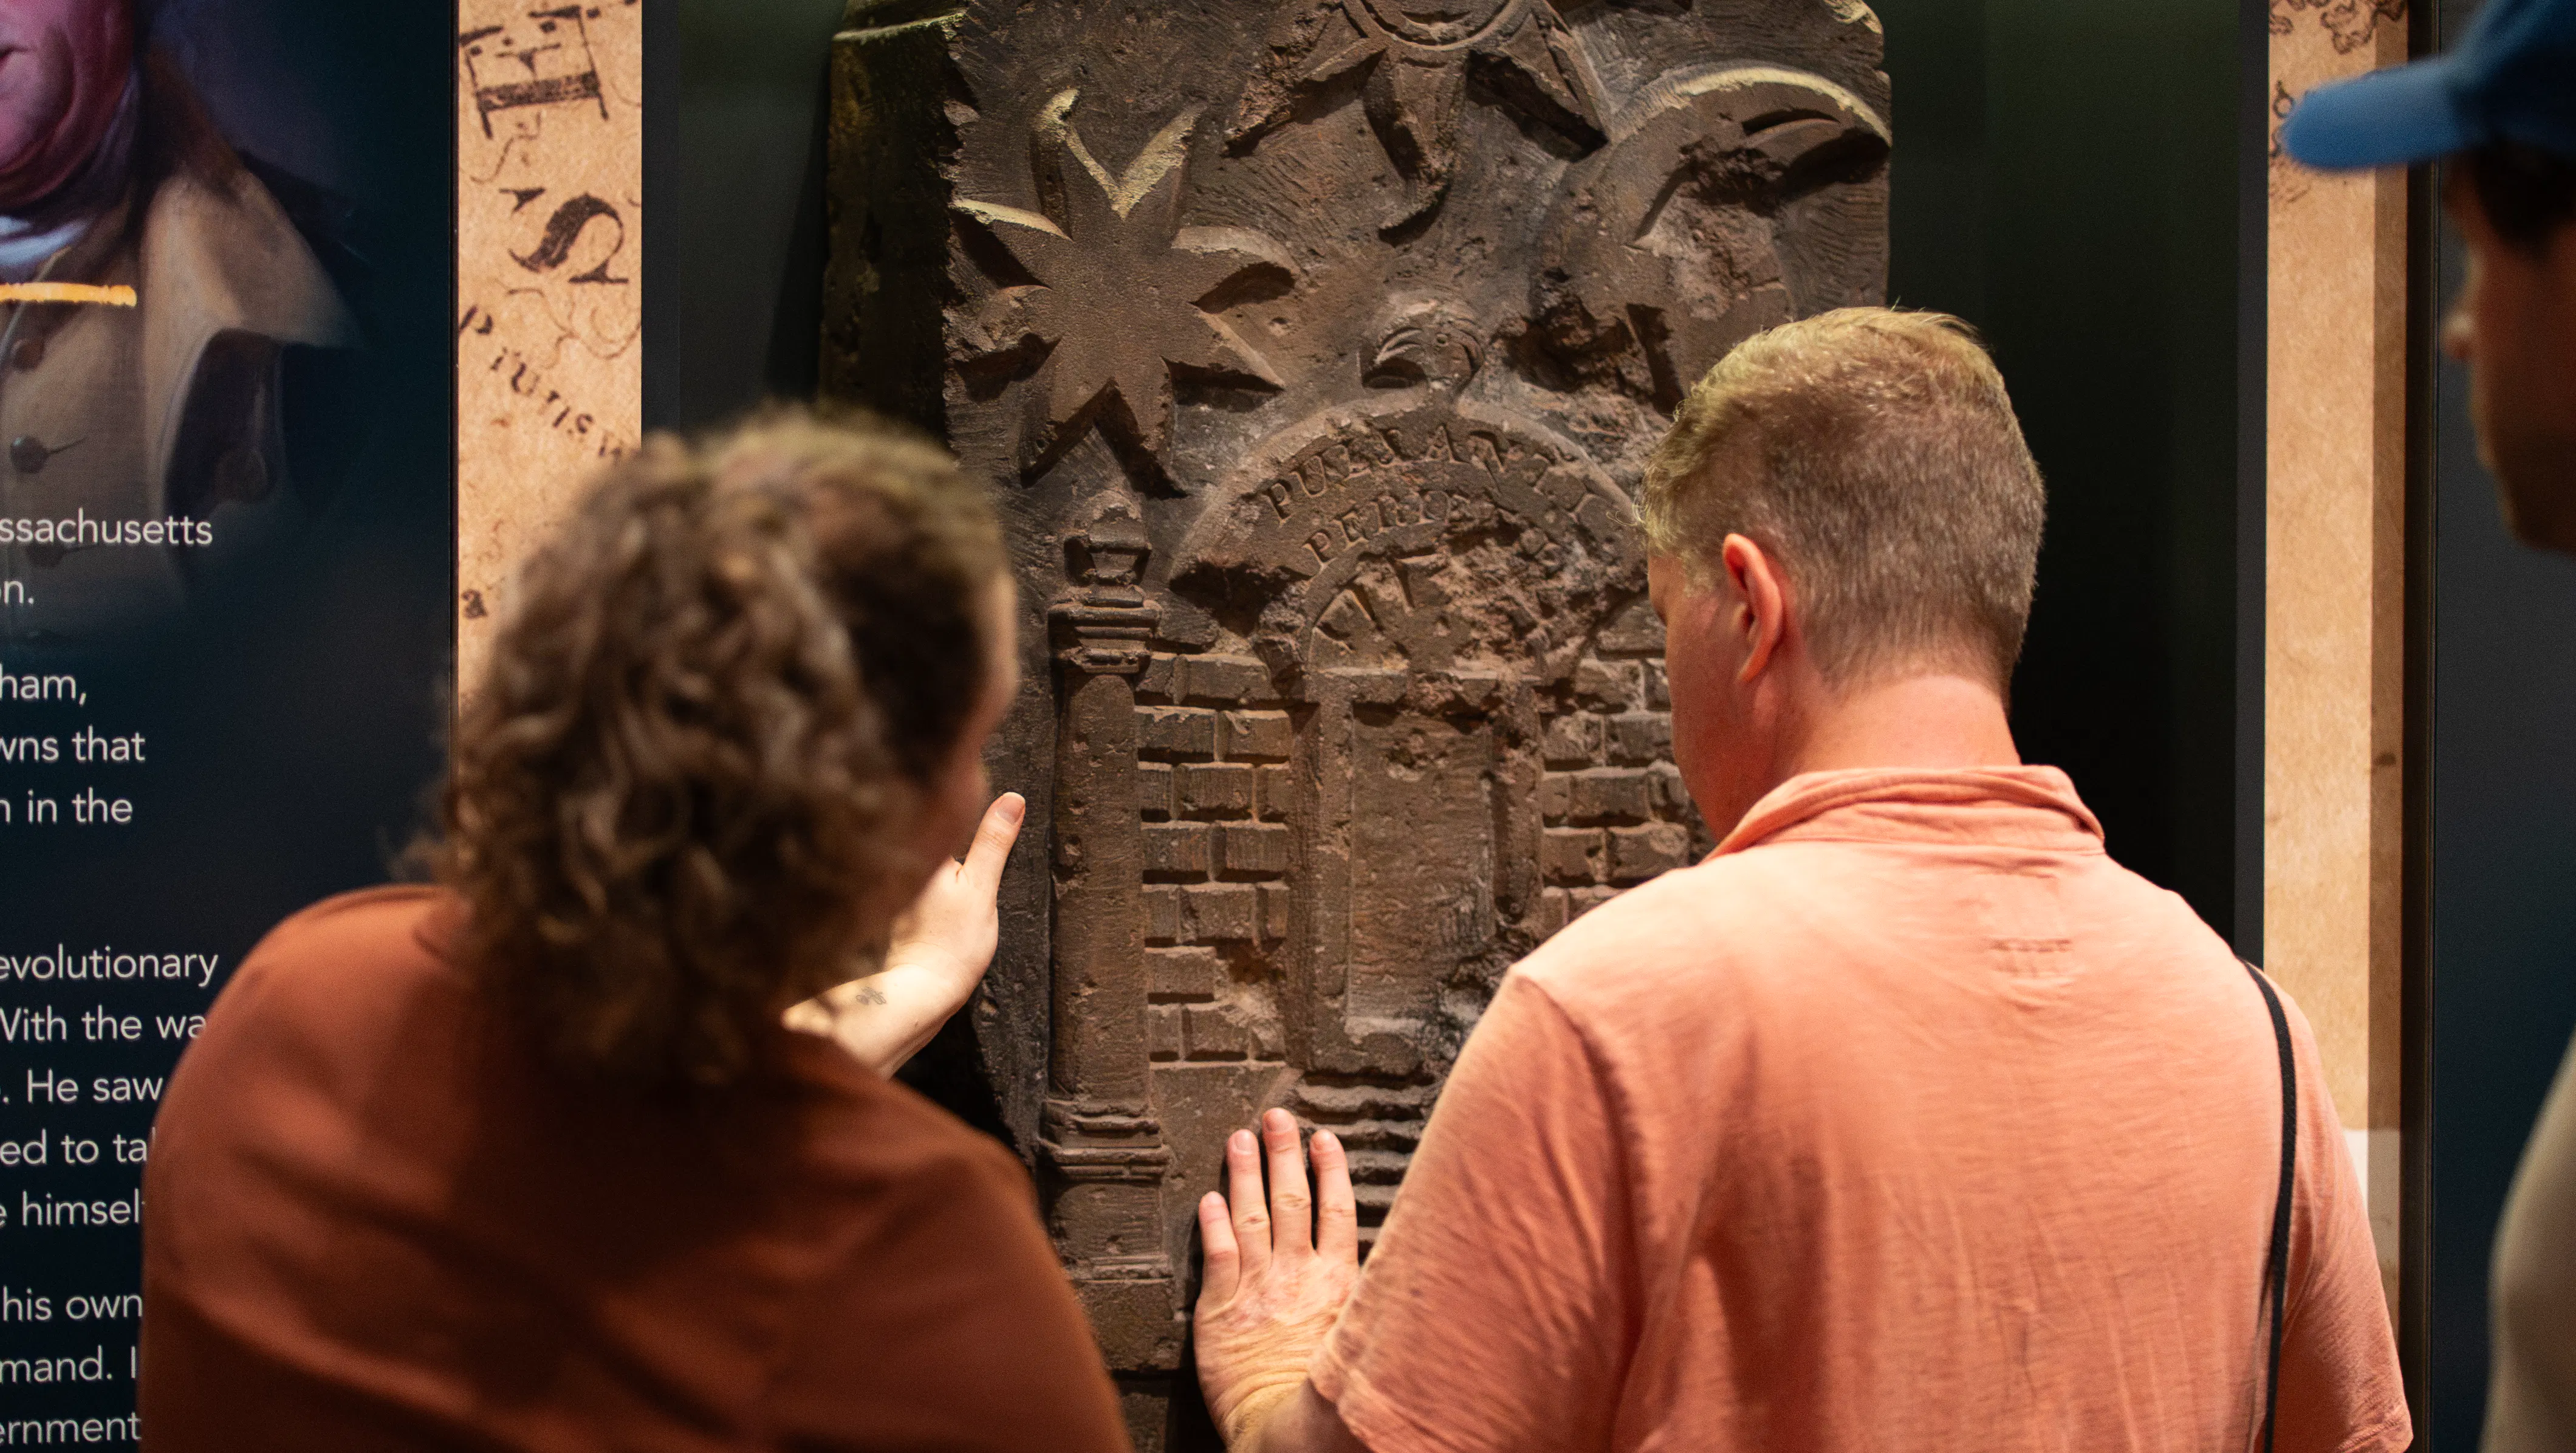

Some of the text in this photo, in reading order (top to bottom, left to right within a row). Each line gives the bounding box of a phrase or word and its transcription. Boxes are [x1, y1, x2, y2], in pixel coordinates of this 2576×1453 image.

[0, 507, 213, 545] ssachusetts
[0, 580, 34, 605] n.
[0, 663, 87, 706] ham,
[72, 726, 146, 762] that
[27, 789, 58, 823] in
[72, 787, 133, 823] the
[0, 943, 219, 988] evolutionary
[81, 1005, 143, 1040] the
[27, 1069, 79, 1103] He
[93, 1077, 163, 1102] saw
[0, 1128, 47, 1165] ed
[61, 1135, 100, 1164] to
[22, 1189, 145, 1226] himsel
[3, 1286, 143, 1321] his own
[0, 1345, 112, 1383] mand.
